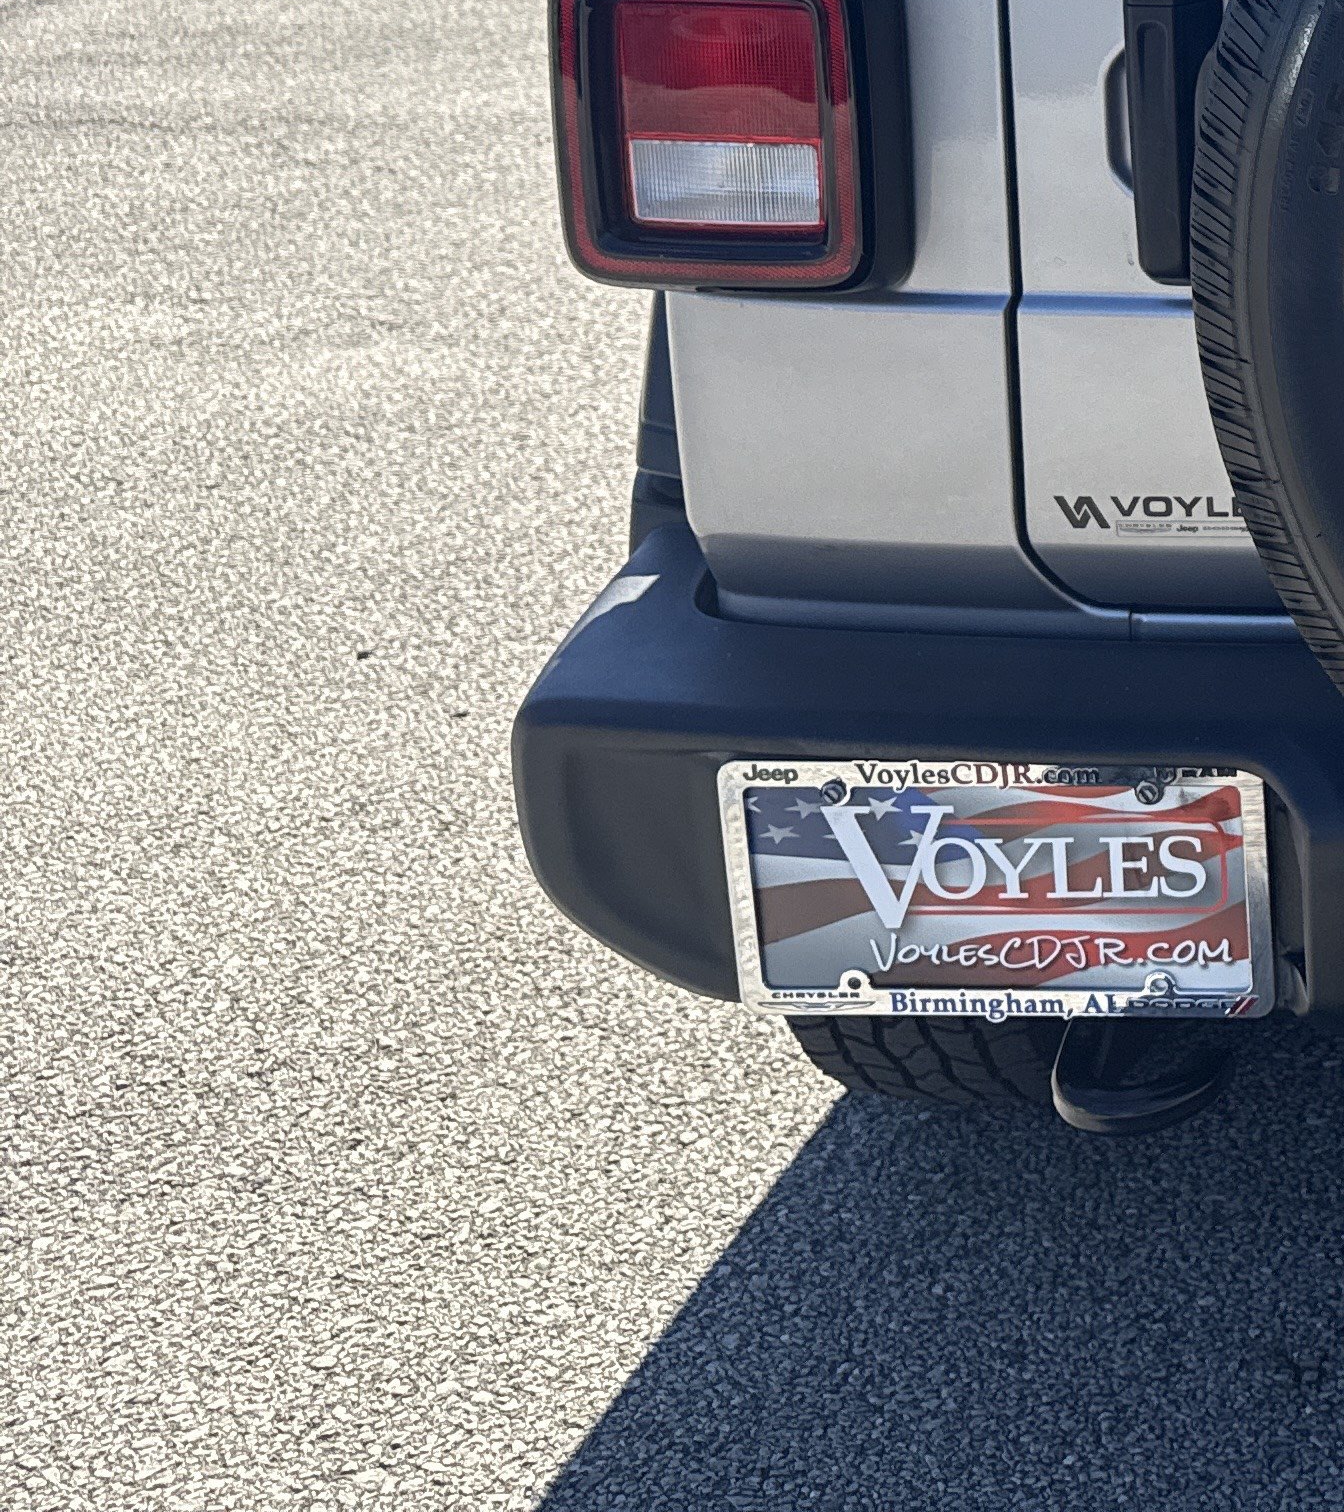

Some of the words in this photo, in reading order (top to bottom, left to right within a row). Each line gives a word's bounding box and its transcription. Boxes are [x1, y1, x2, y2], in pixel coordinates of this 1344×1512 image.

[743, 764, 799, 785] Jeep
[854, 763, 1101, 791] VoylesCDJR.com
[821, 805, 1208, 929] VOYLES
[890, 989, 1074, 1021] Birmingham,
